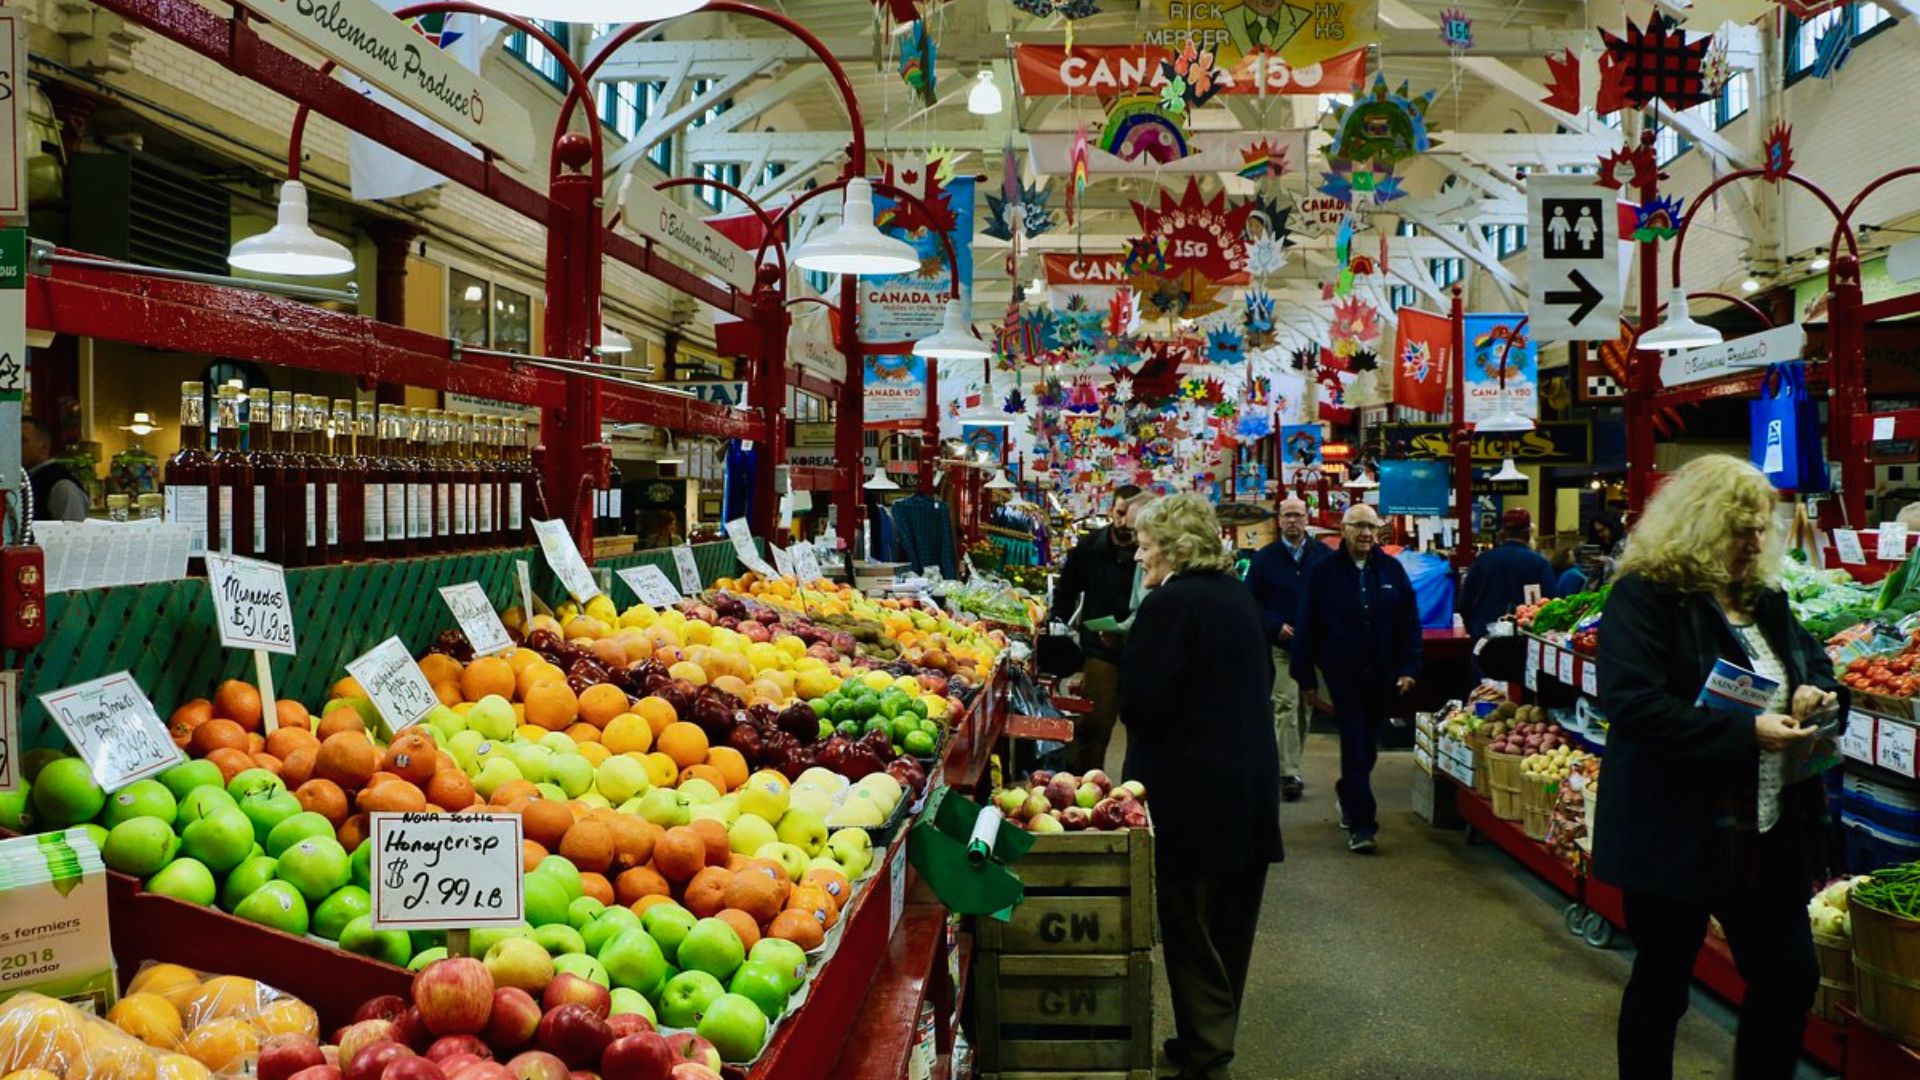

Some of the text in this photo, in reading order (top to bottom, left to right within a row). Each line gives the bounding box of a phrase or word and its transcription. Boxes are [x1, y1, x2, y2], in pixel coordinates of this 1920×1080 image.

[1147, 3, 1231, 46] RICK MERCER
[1315, 2, 1344, 40] HV HS
[403, 43, 469, 115] Produce
[1060, 57, 1323, 88] CANAA 150
[1173, 239, 1208, 258] 150
[1069, 261, 1130, 280] CAN
[868, 291, 951, 304] CANADA 15
[402, 812, 440, 824] NOVA
[384, 830, 500, 868] Honeycrisp
[385, 857, 503, 910] $ 2.99 LB
[14, 918, 81, 939] fermiers
[1039, 912, 1100, 944] GW
[1, 947, 55, 971] 2018
[2, 962, 61, 981] Calendar
